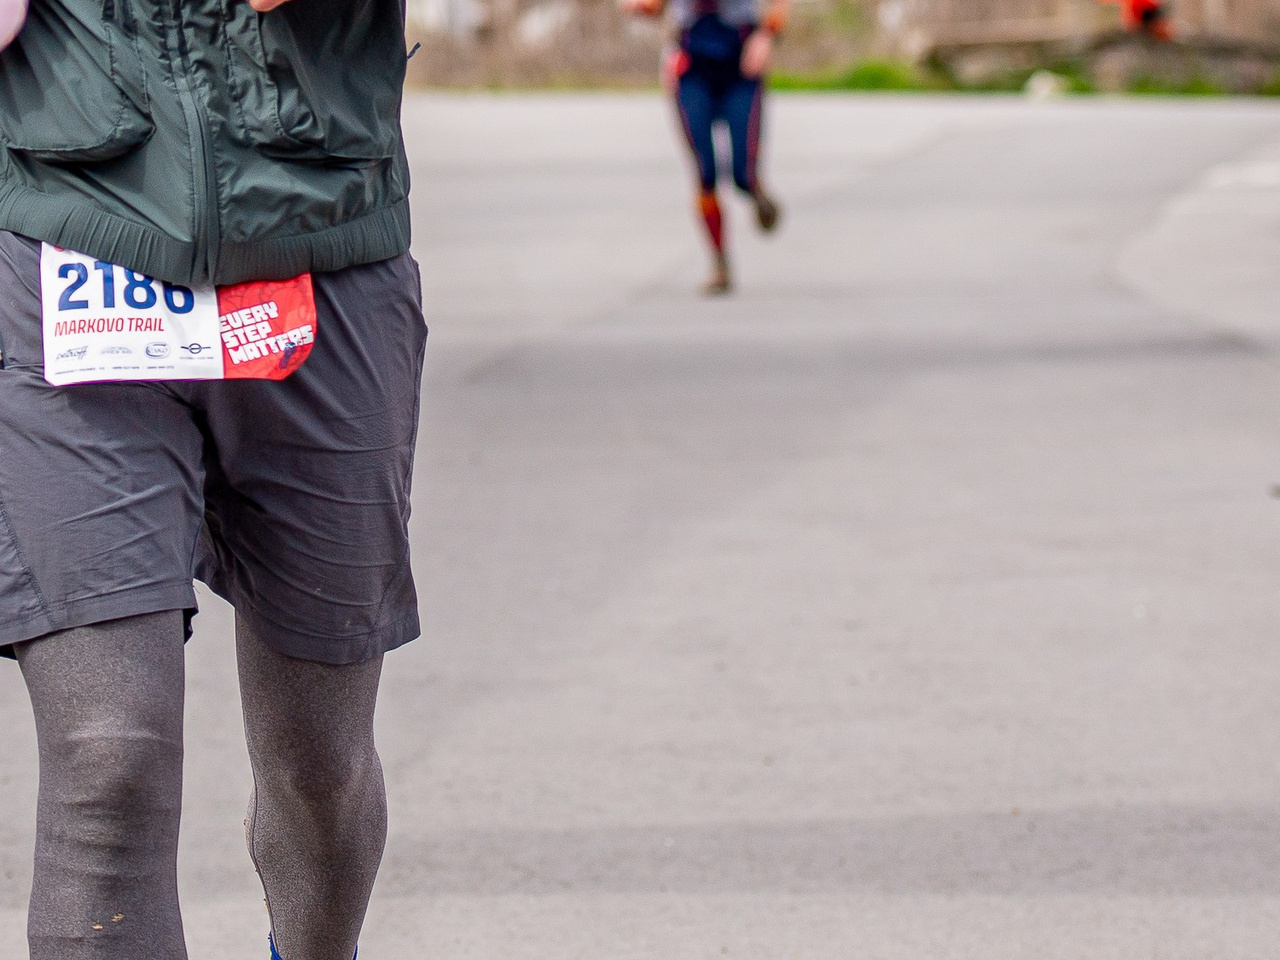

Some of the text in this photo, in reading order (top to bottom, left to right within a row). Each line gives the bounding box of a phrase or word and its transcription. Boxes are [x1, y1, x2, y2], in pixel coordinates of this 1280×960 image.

[57, 260, 195, 315] 2186
[54, 317, 165, 337] MARKOVO TRAIL
[219, 301, 279, 333] EVERY
[221, 321, 272, 349] STEP
[228, 324, 314, 365] MATTERS
